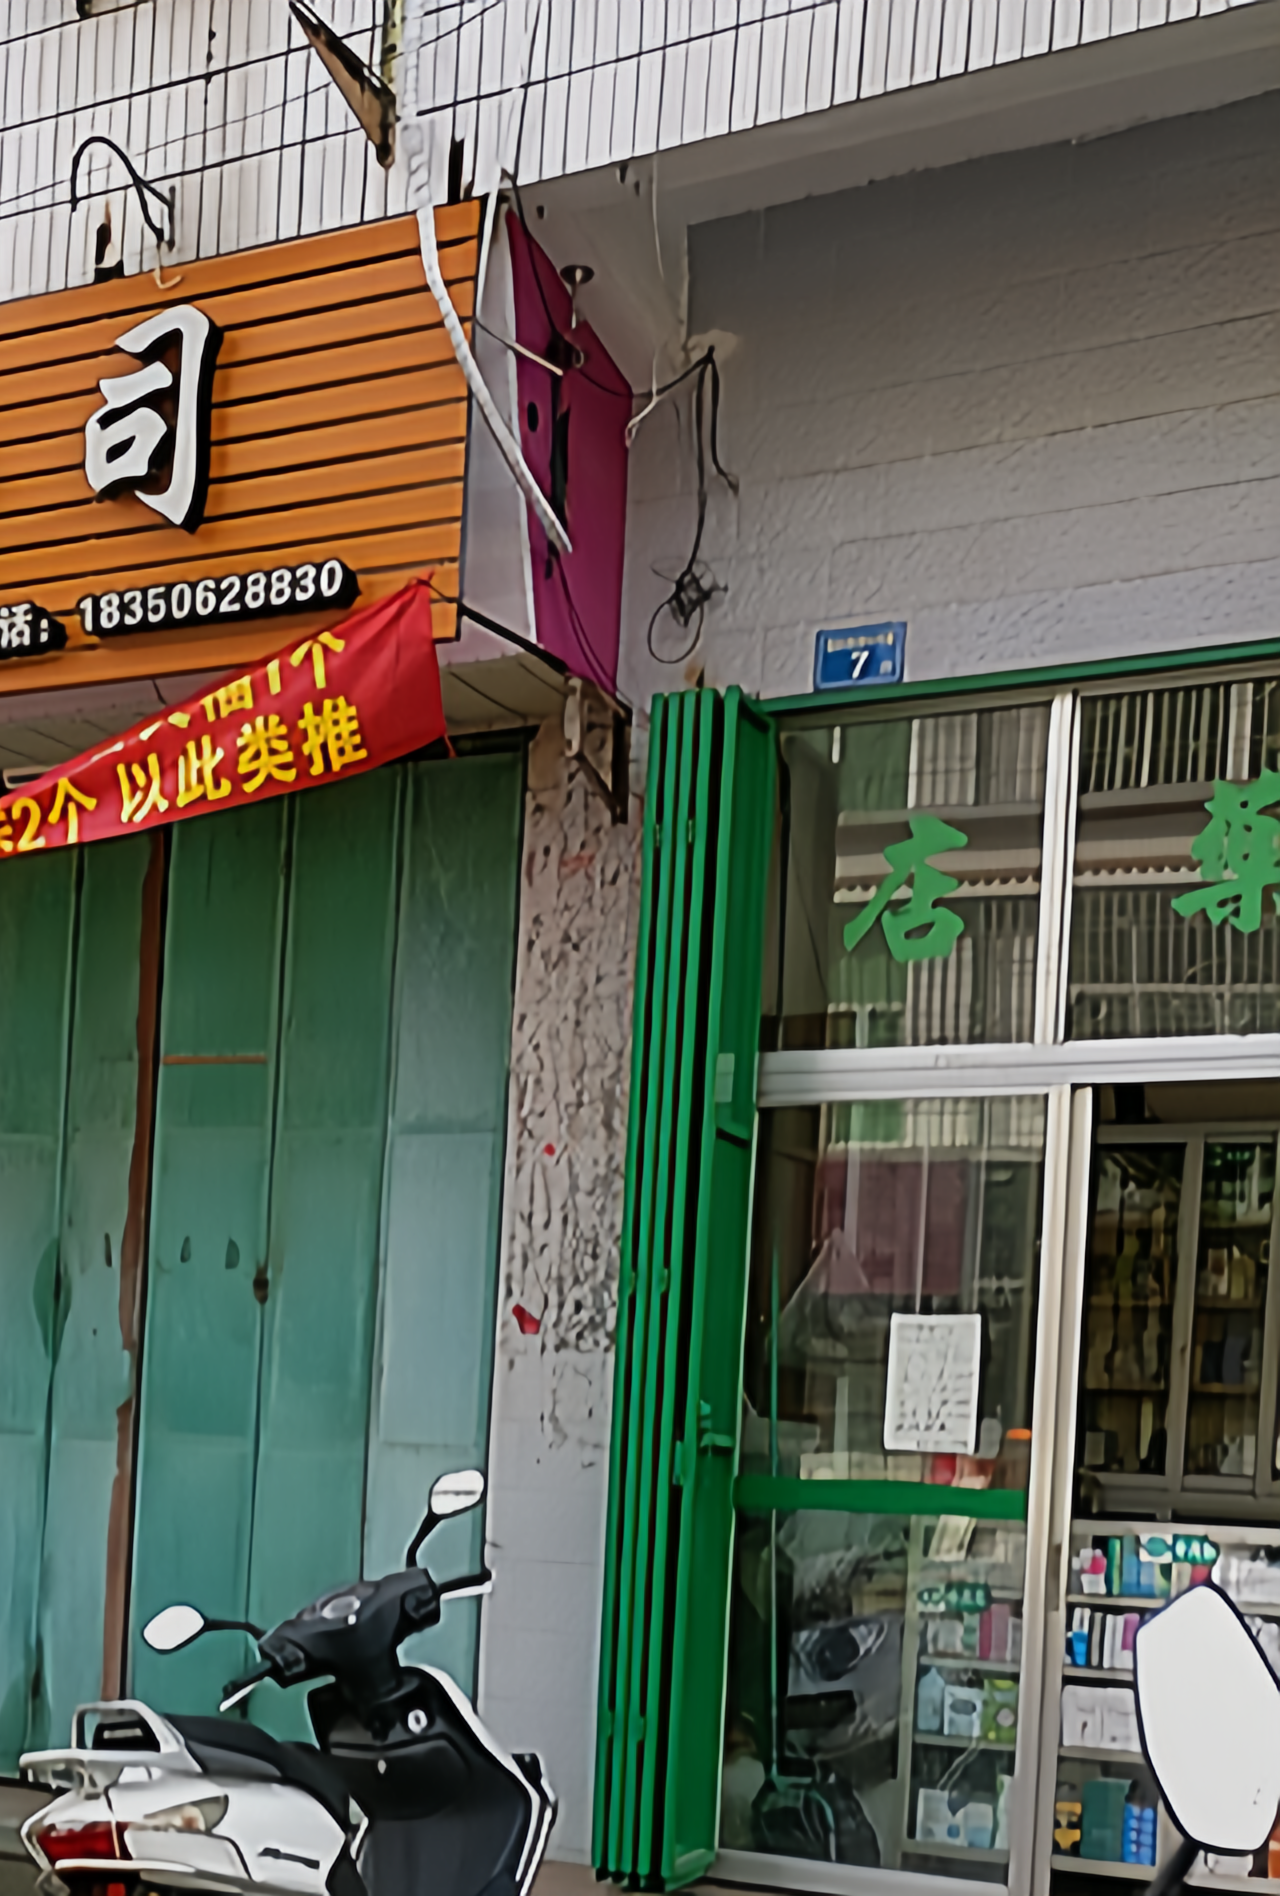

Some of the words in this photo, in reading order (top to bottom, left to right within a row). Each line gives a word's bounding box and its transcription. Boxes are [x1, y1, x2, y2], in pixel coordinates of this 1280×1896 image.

[79, 558, 344, 634] 18350628830
[851, 650, 869, 679] 7
[116, 695, 368, 823] 以此类推
[843, 815, 969, 963] 店
